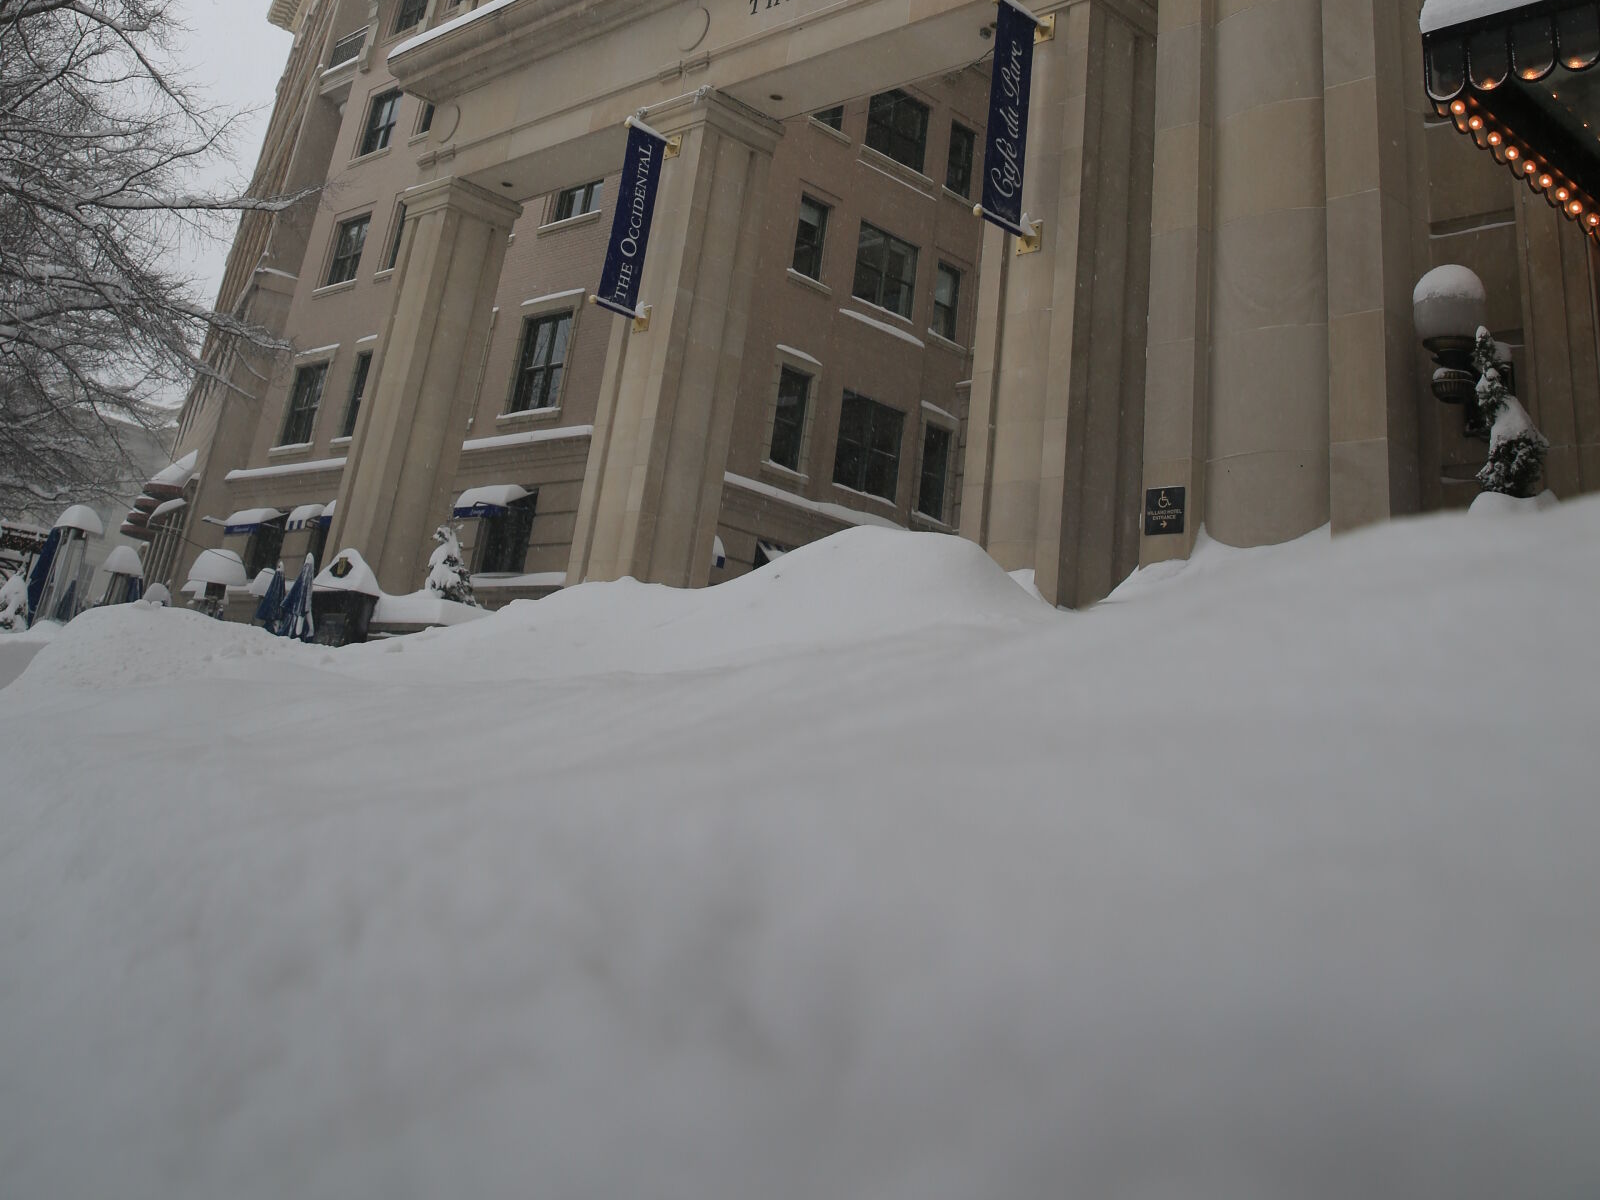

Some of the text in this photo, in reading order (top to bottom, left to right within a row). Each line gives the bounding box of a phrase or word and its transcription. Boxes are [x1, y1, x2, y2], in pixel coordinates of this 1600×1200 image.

[1000, 107, 1019, 139] du
[991, 138, 1022, 198] Café
[613, 262, 633, 301] THE
